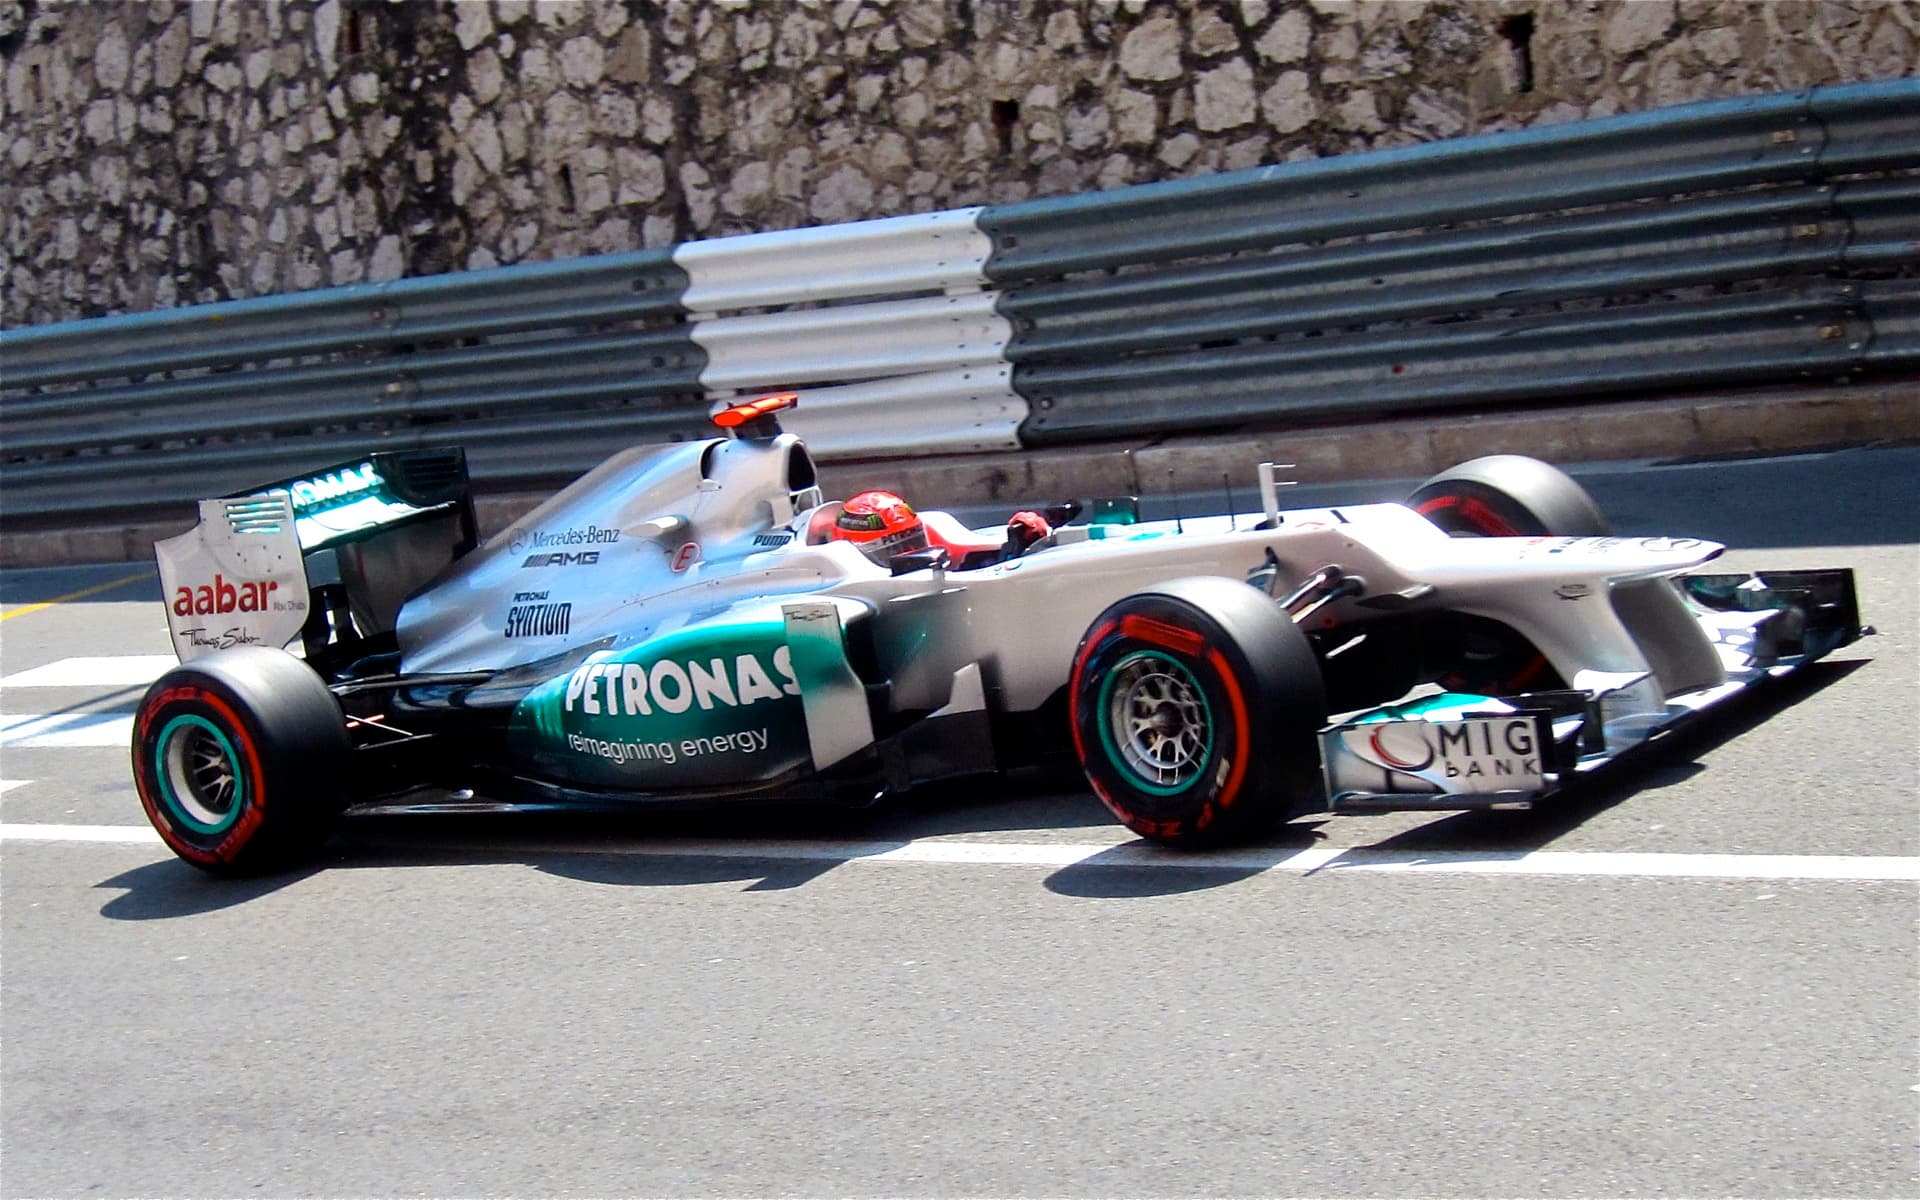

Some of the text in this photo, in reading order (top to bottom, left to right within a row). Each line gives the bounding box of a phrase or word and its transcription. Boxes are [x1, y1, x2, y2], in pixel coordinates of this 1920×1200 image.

[529, 525, 621, 549] Mercedes-Benz
[752, 535, 792, 546] PUMA
[545, 551, 600, 567] AMG
[173, 574, 278, 617] aabar
[504, 602, 572, 638] SYNTIUM
[565, 645, 801, 716] PETRONAS
[567, 727, 768, 765] reimagining energy
[1437, 720, 1533, 758] MIG
